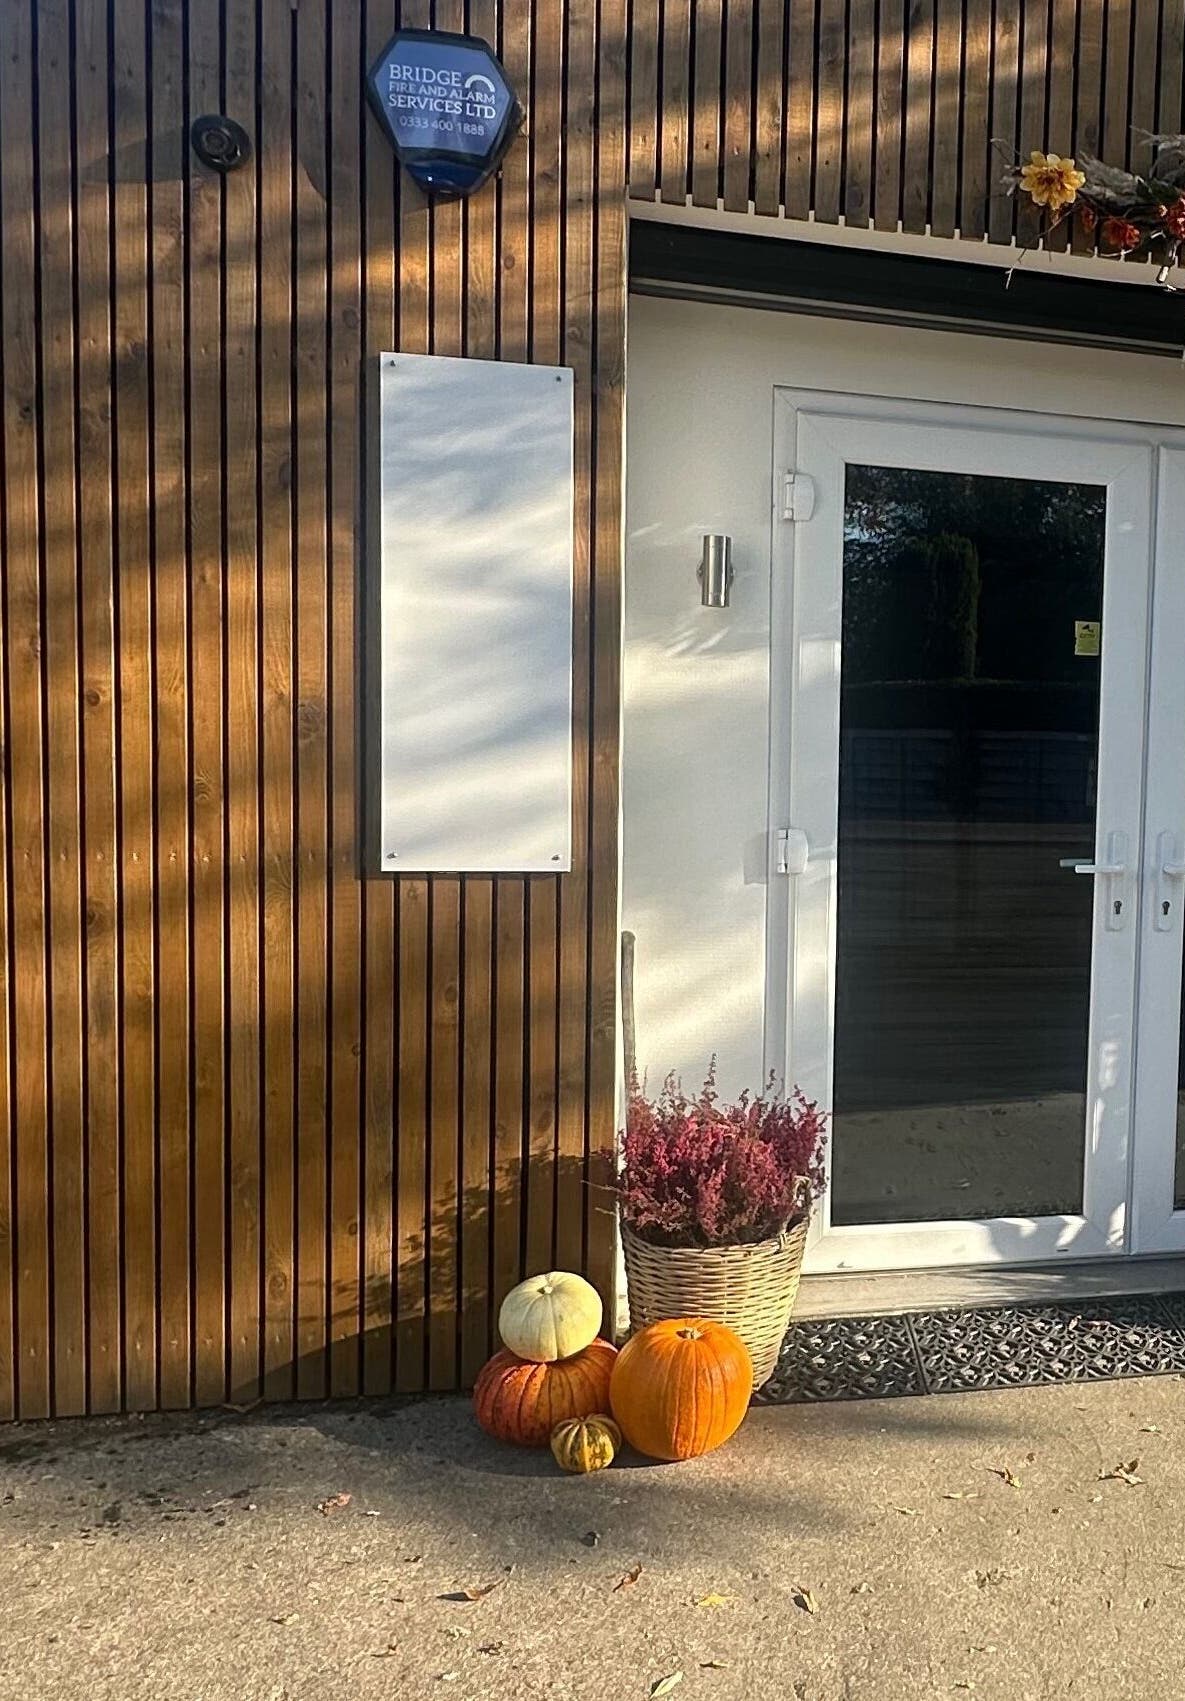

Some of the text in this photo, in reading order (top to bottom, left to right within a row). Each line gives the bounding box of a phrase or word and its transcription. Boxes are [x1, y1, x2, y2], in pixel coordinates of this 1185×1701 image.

[389, 65, 462, 87] BRIDGE
[389, 81, 496, 105] FIRE AND ALARM
[388, 94, 496, 119] SERVICES LTD
[400, 116, 429, 129] 0333
[431, 120, 453, 131] 400
